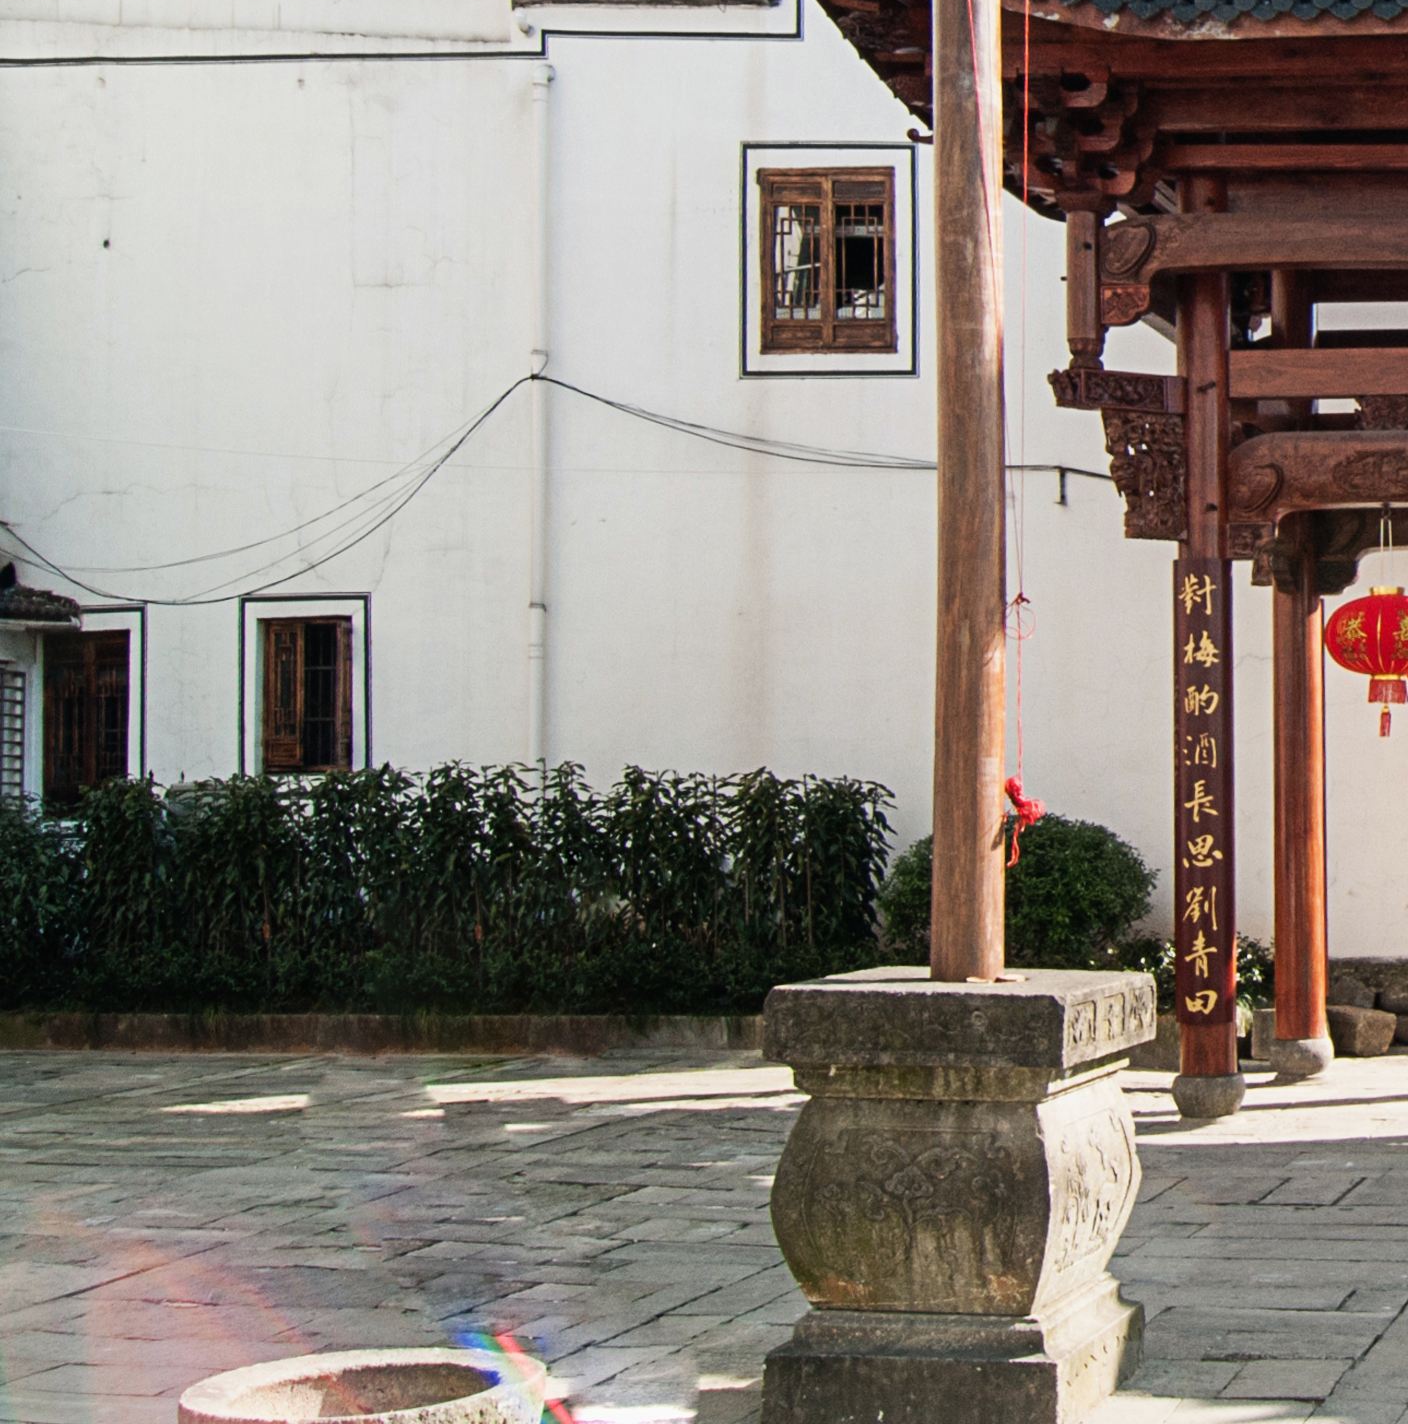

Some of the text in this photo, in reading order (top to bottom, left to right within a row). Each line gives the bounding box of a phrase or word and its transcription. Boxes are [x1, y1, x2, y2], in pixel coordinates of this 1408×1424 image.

[1178, 573, 1223, 1015] 對梅酌酒長思劉青田
